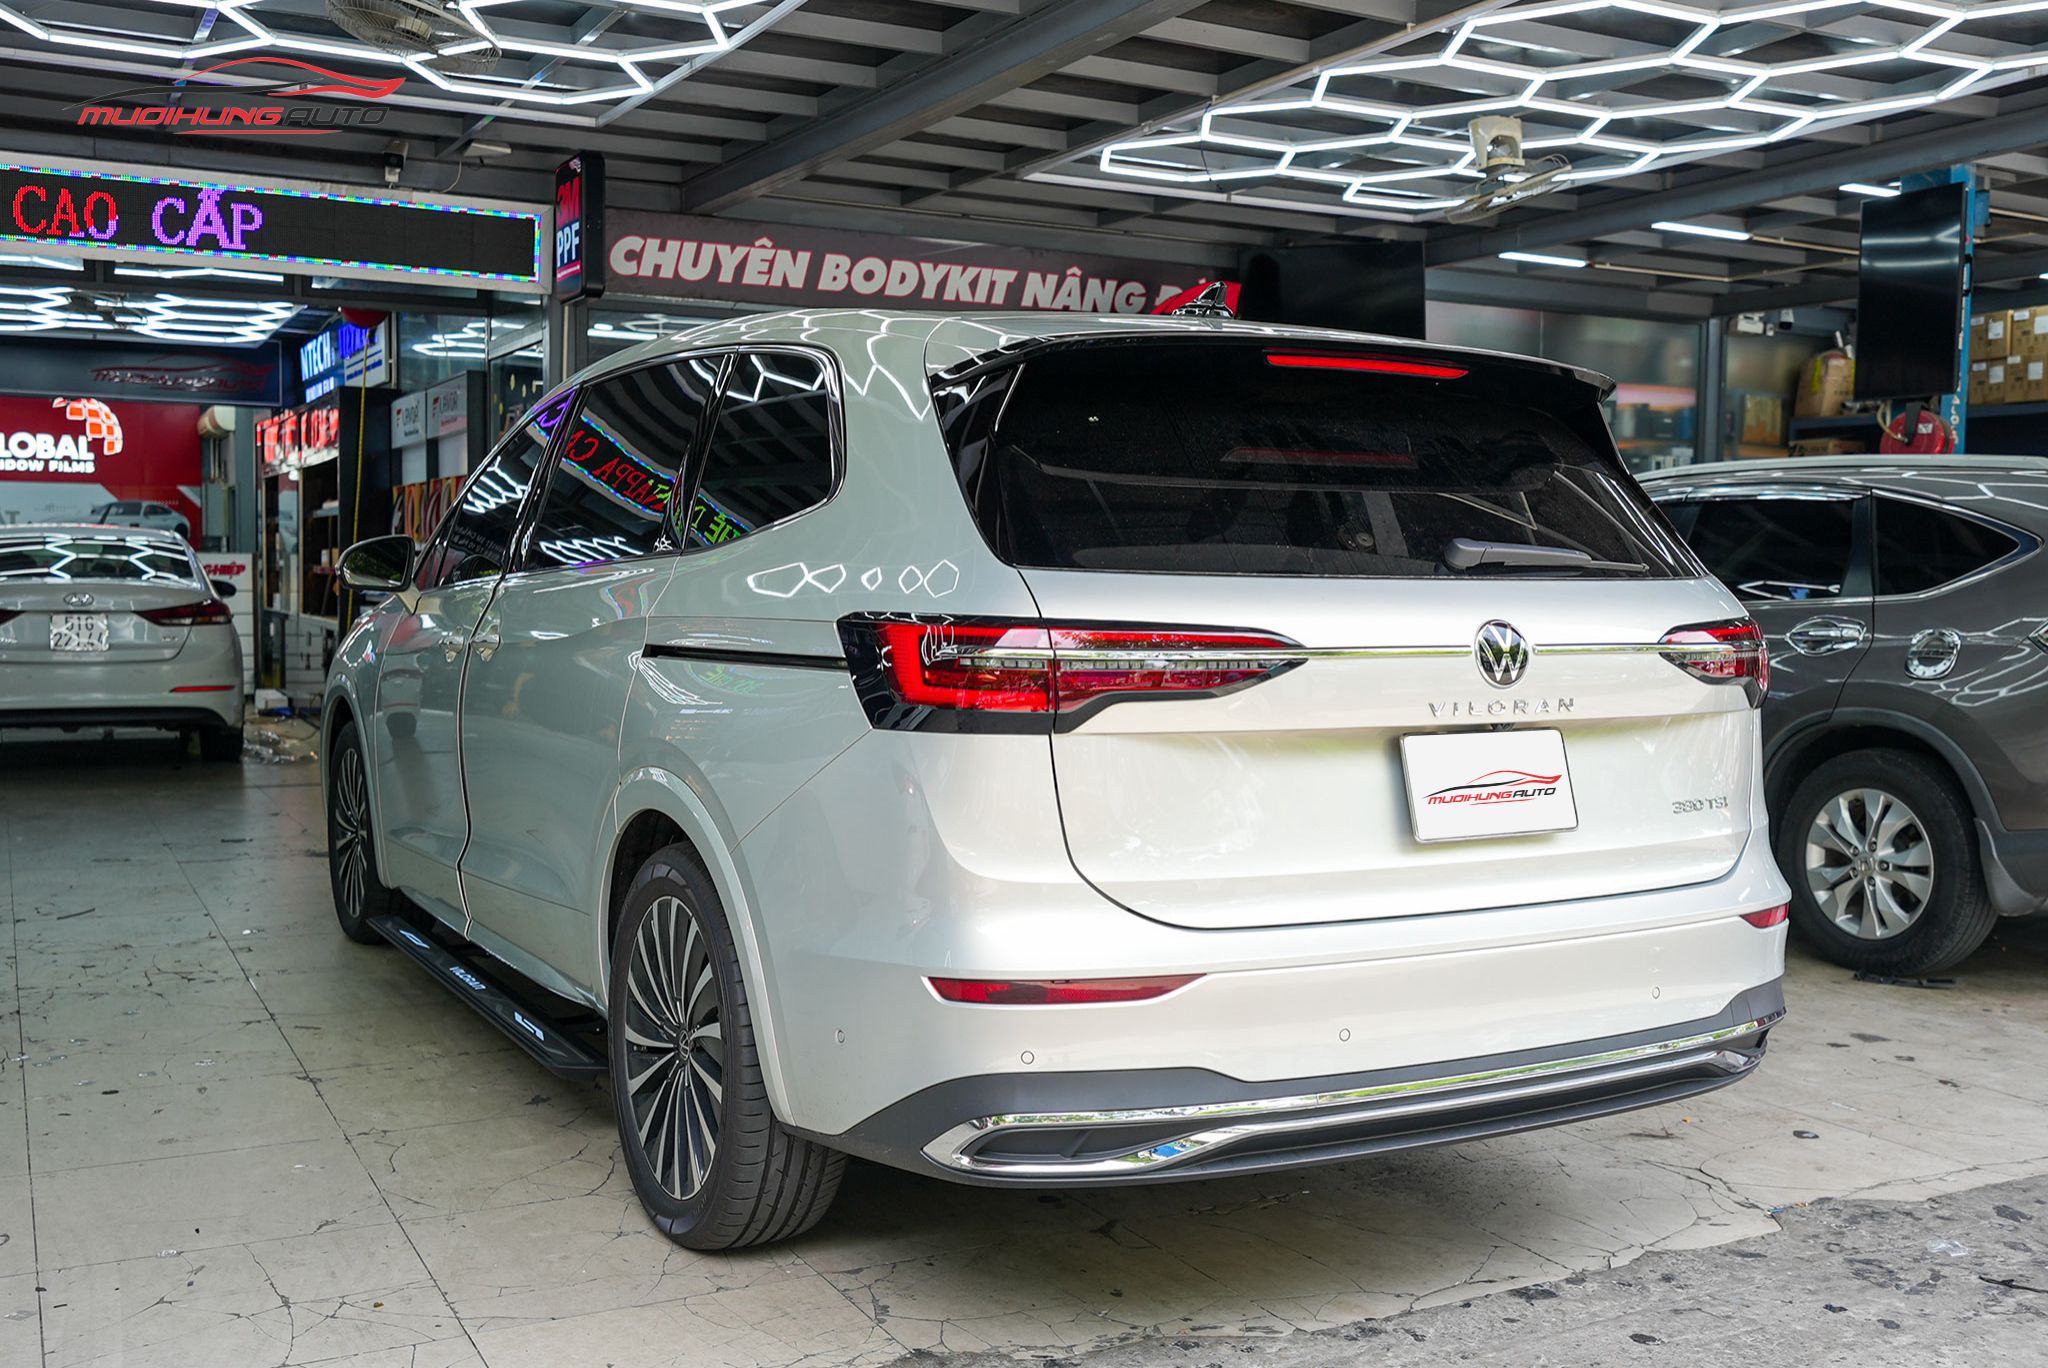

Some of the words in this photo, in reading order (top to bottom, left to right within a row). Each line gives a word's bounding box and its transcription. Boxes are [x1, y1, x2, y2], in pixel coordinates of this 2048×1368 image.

[13, 185, 118, 240] CAO
[152, 187, 263, 250] CẤP
[556, 221, 580, 268] PPF
[609, 236, 811, 289] CHUYÊN
[817, 253, 1018, 305] BODYKIT
[1021, 266, 1147, 314] NÂNG
[48, 460, 95, 474] FILMS
[65, 615, 94, 631] 51G
[1427, 697, 1575, 718] VILORAN
[1705, 796, 1728, 810] TSI
